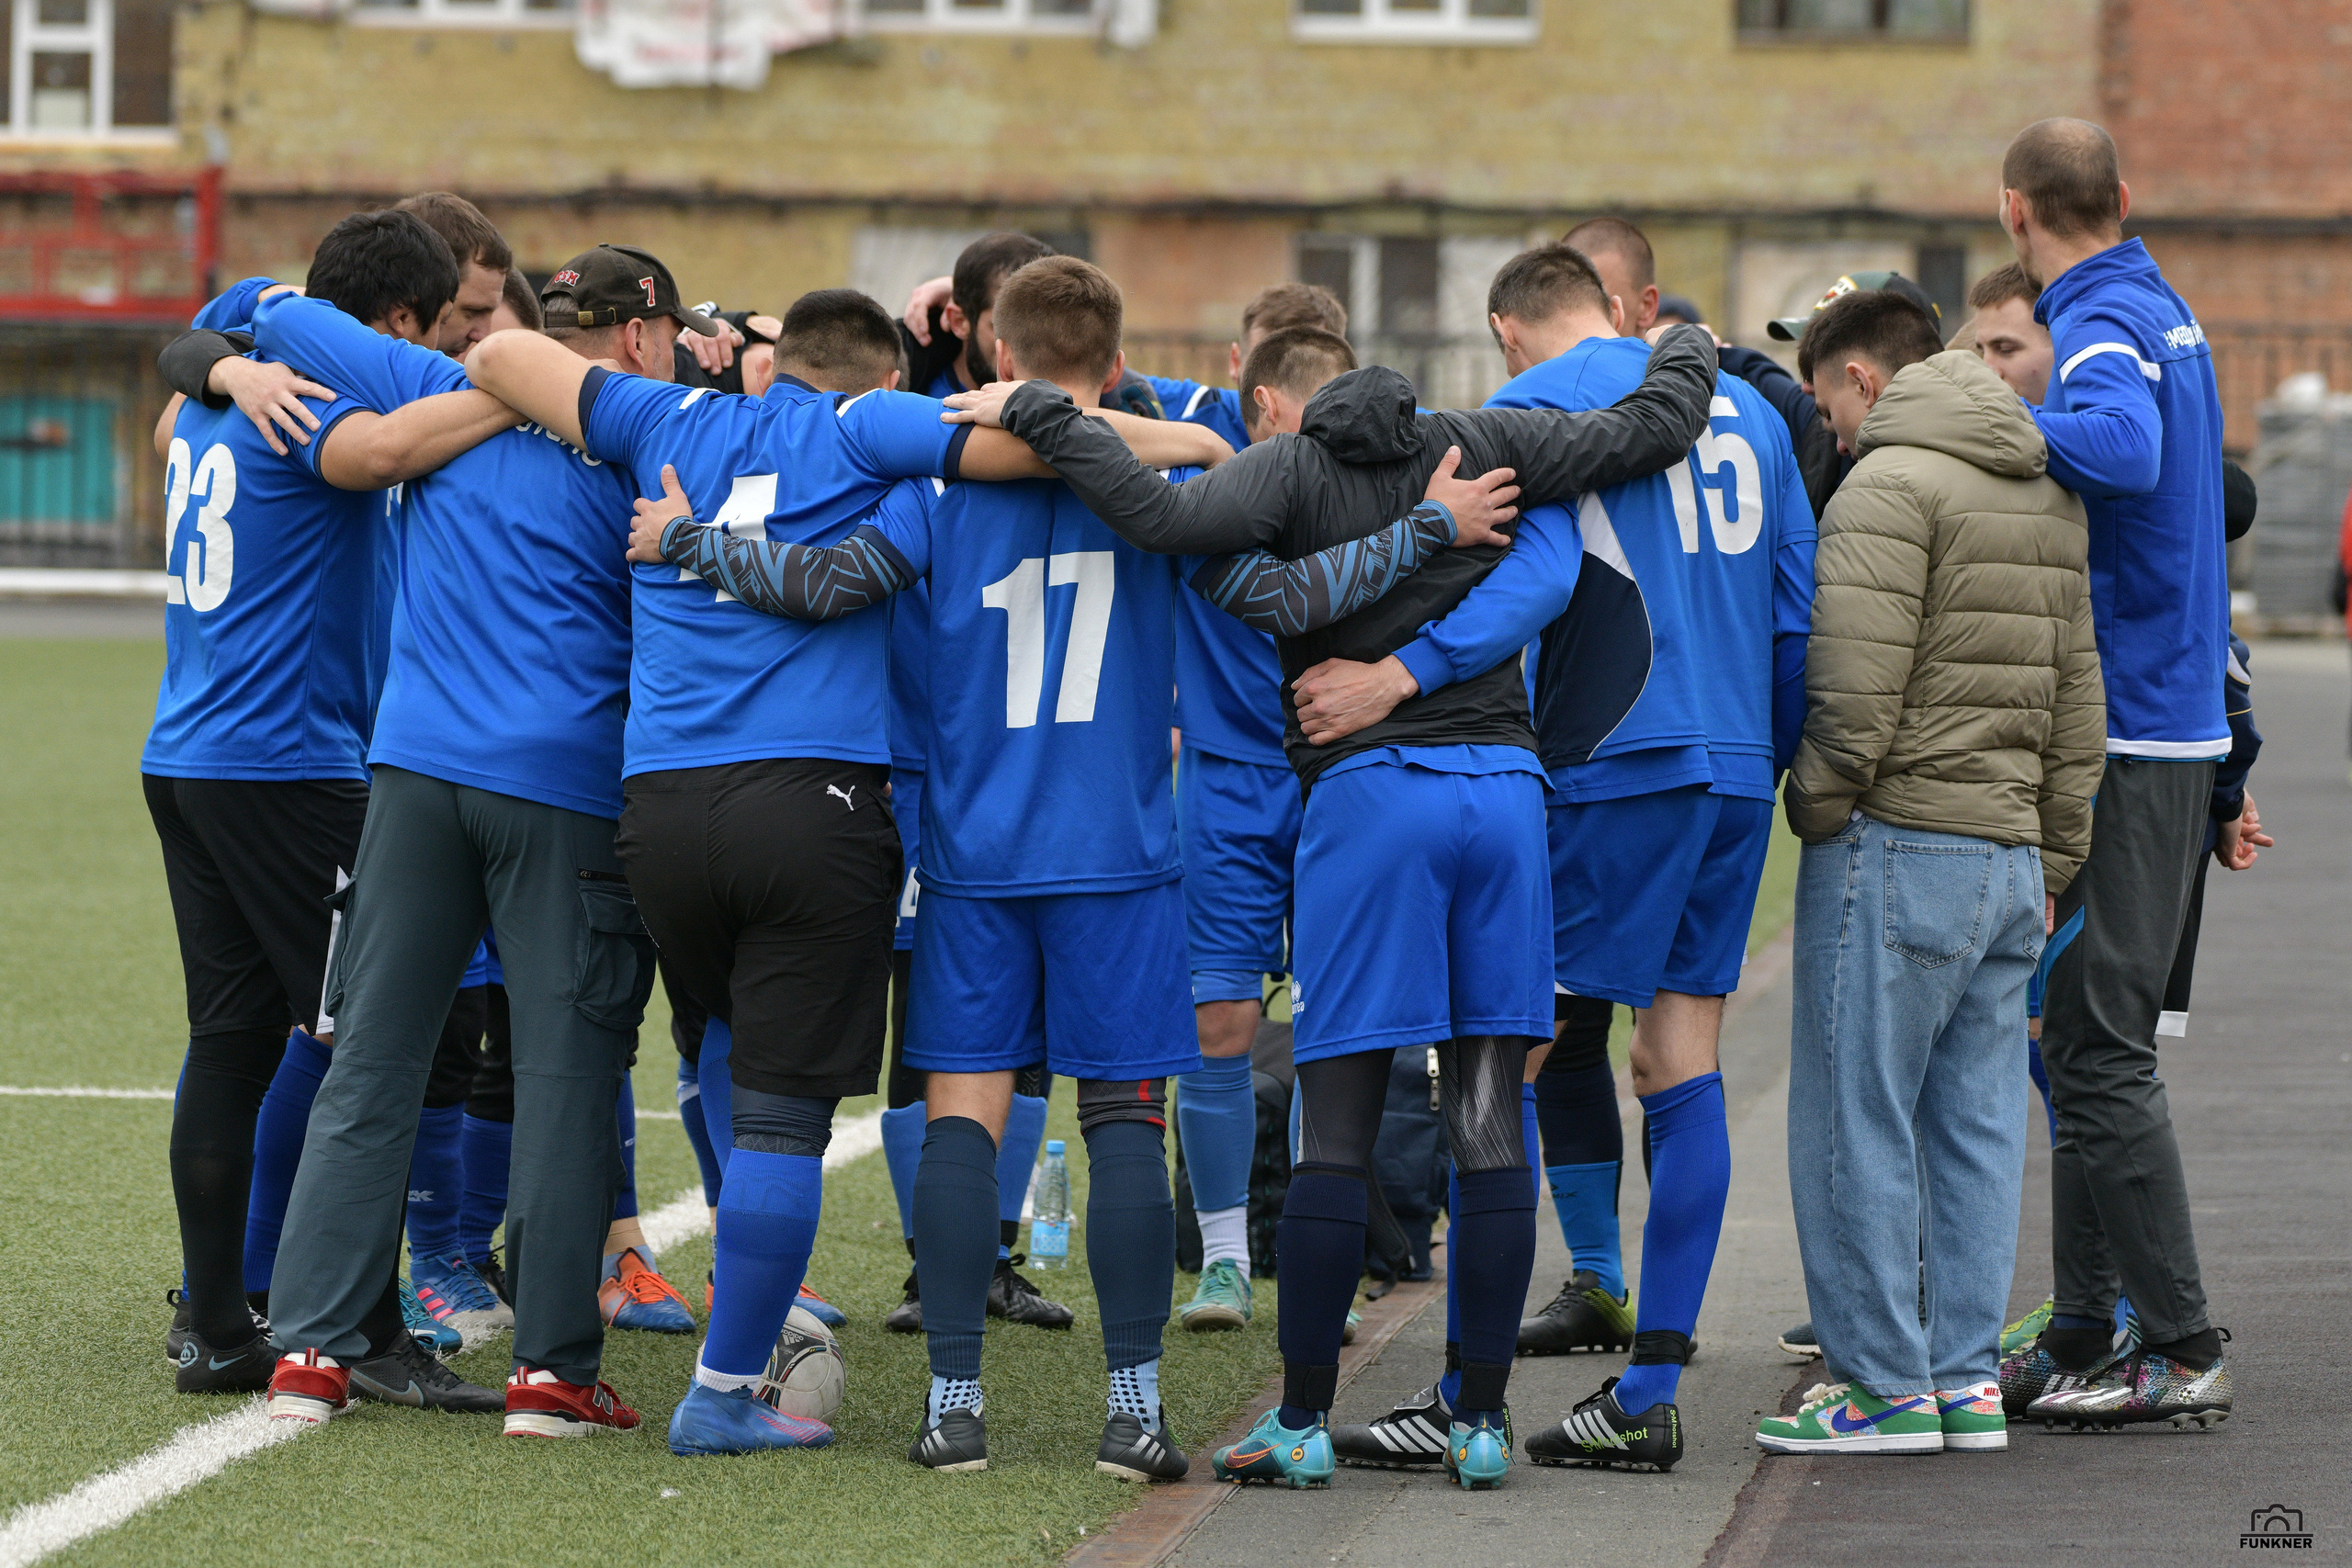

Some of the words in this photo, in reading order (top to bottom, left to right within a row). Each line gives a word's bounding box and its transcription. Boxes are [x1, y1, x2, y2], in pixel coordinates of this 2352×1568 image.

[639, 276, 655, 307] 7
[164, 436, 237, 613] 23
[1665, 395, 1763, 555] 15
[982, 550, 1115, 728] 17
[1983, 1387, 2000, 1397] NIKE
